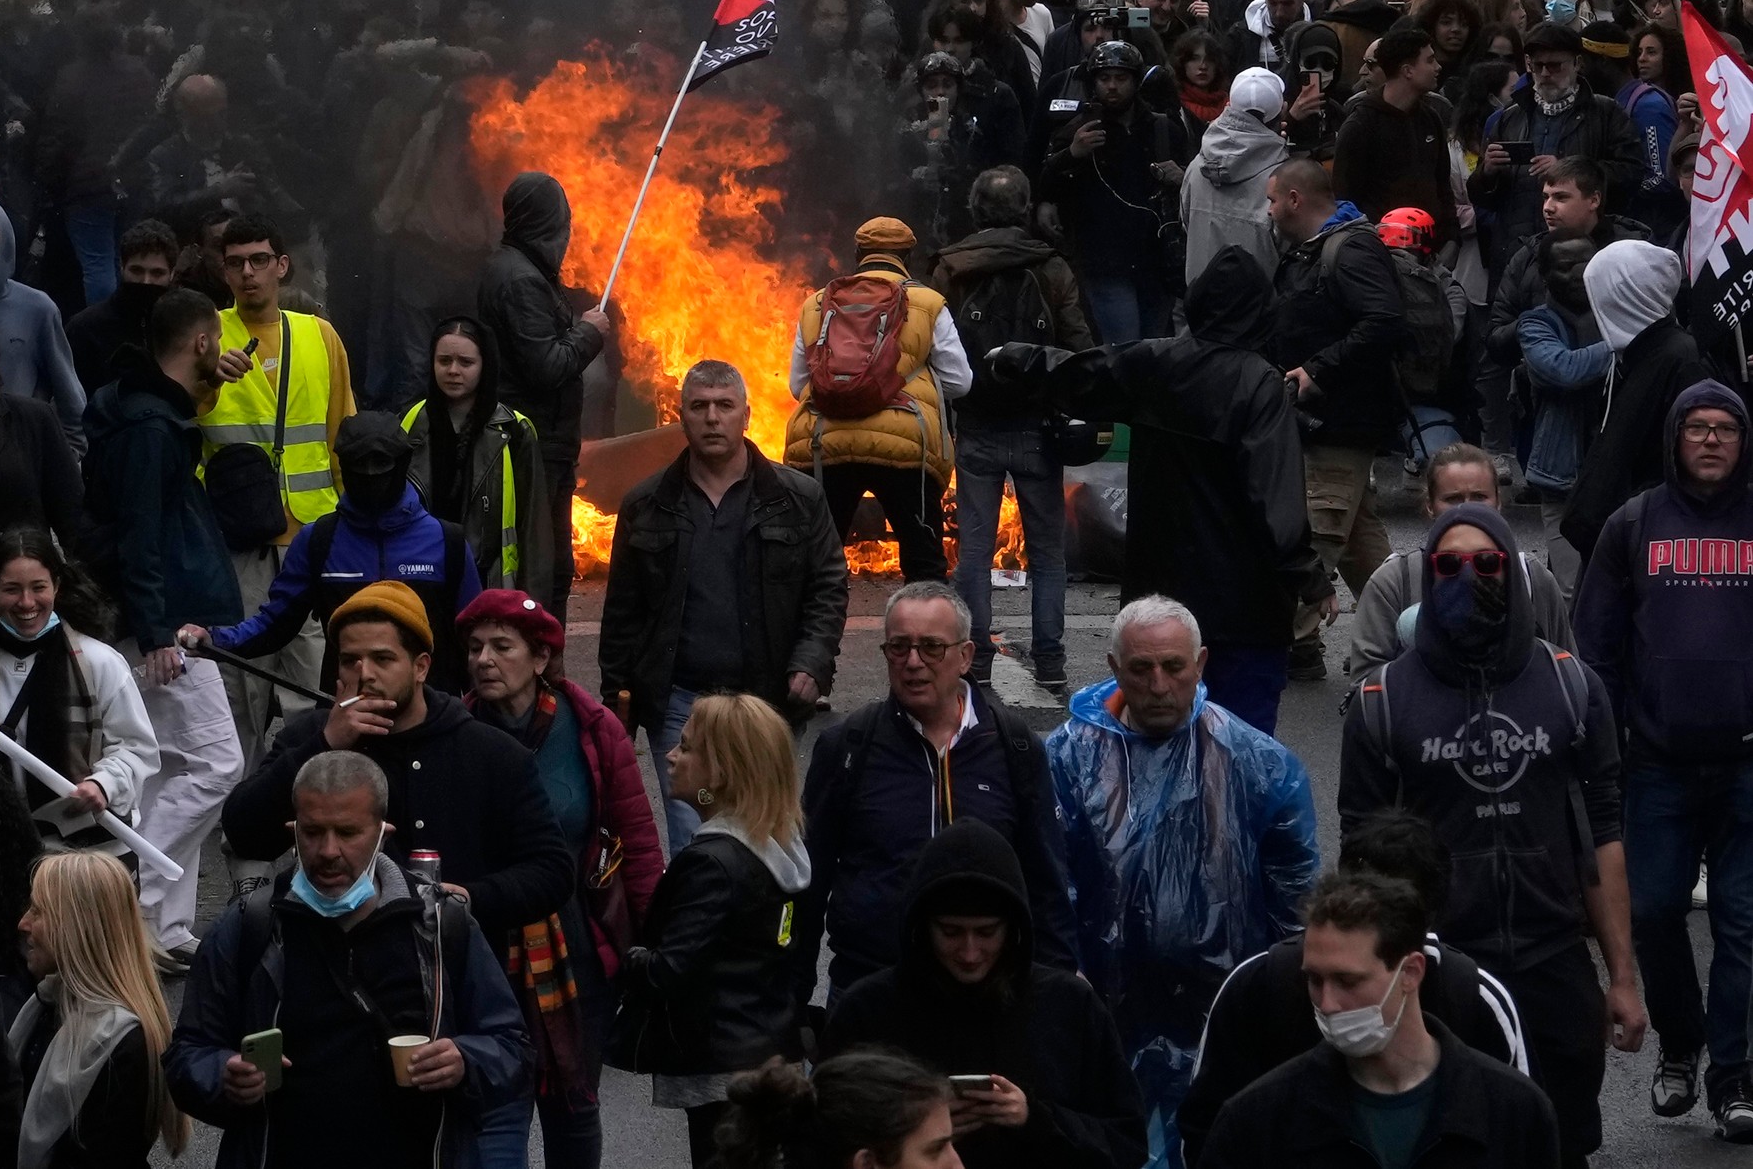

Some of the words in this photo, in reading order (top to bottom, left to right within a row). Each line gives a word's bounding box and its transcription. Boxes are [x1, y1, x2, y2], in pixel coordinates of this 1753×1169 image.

[1648, 538, 1753, 576] PUMA
[406, 564, 435, 573] YAMAHA
[1665, 579, 1749, 587] SPORTSWEAR
[1490, 725, 1552, 759] Rock
